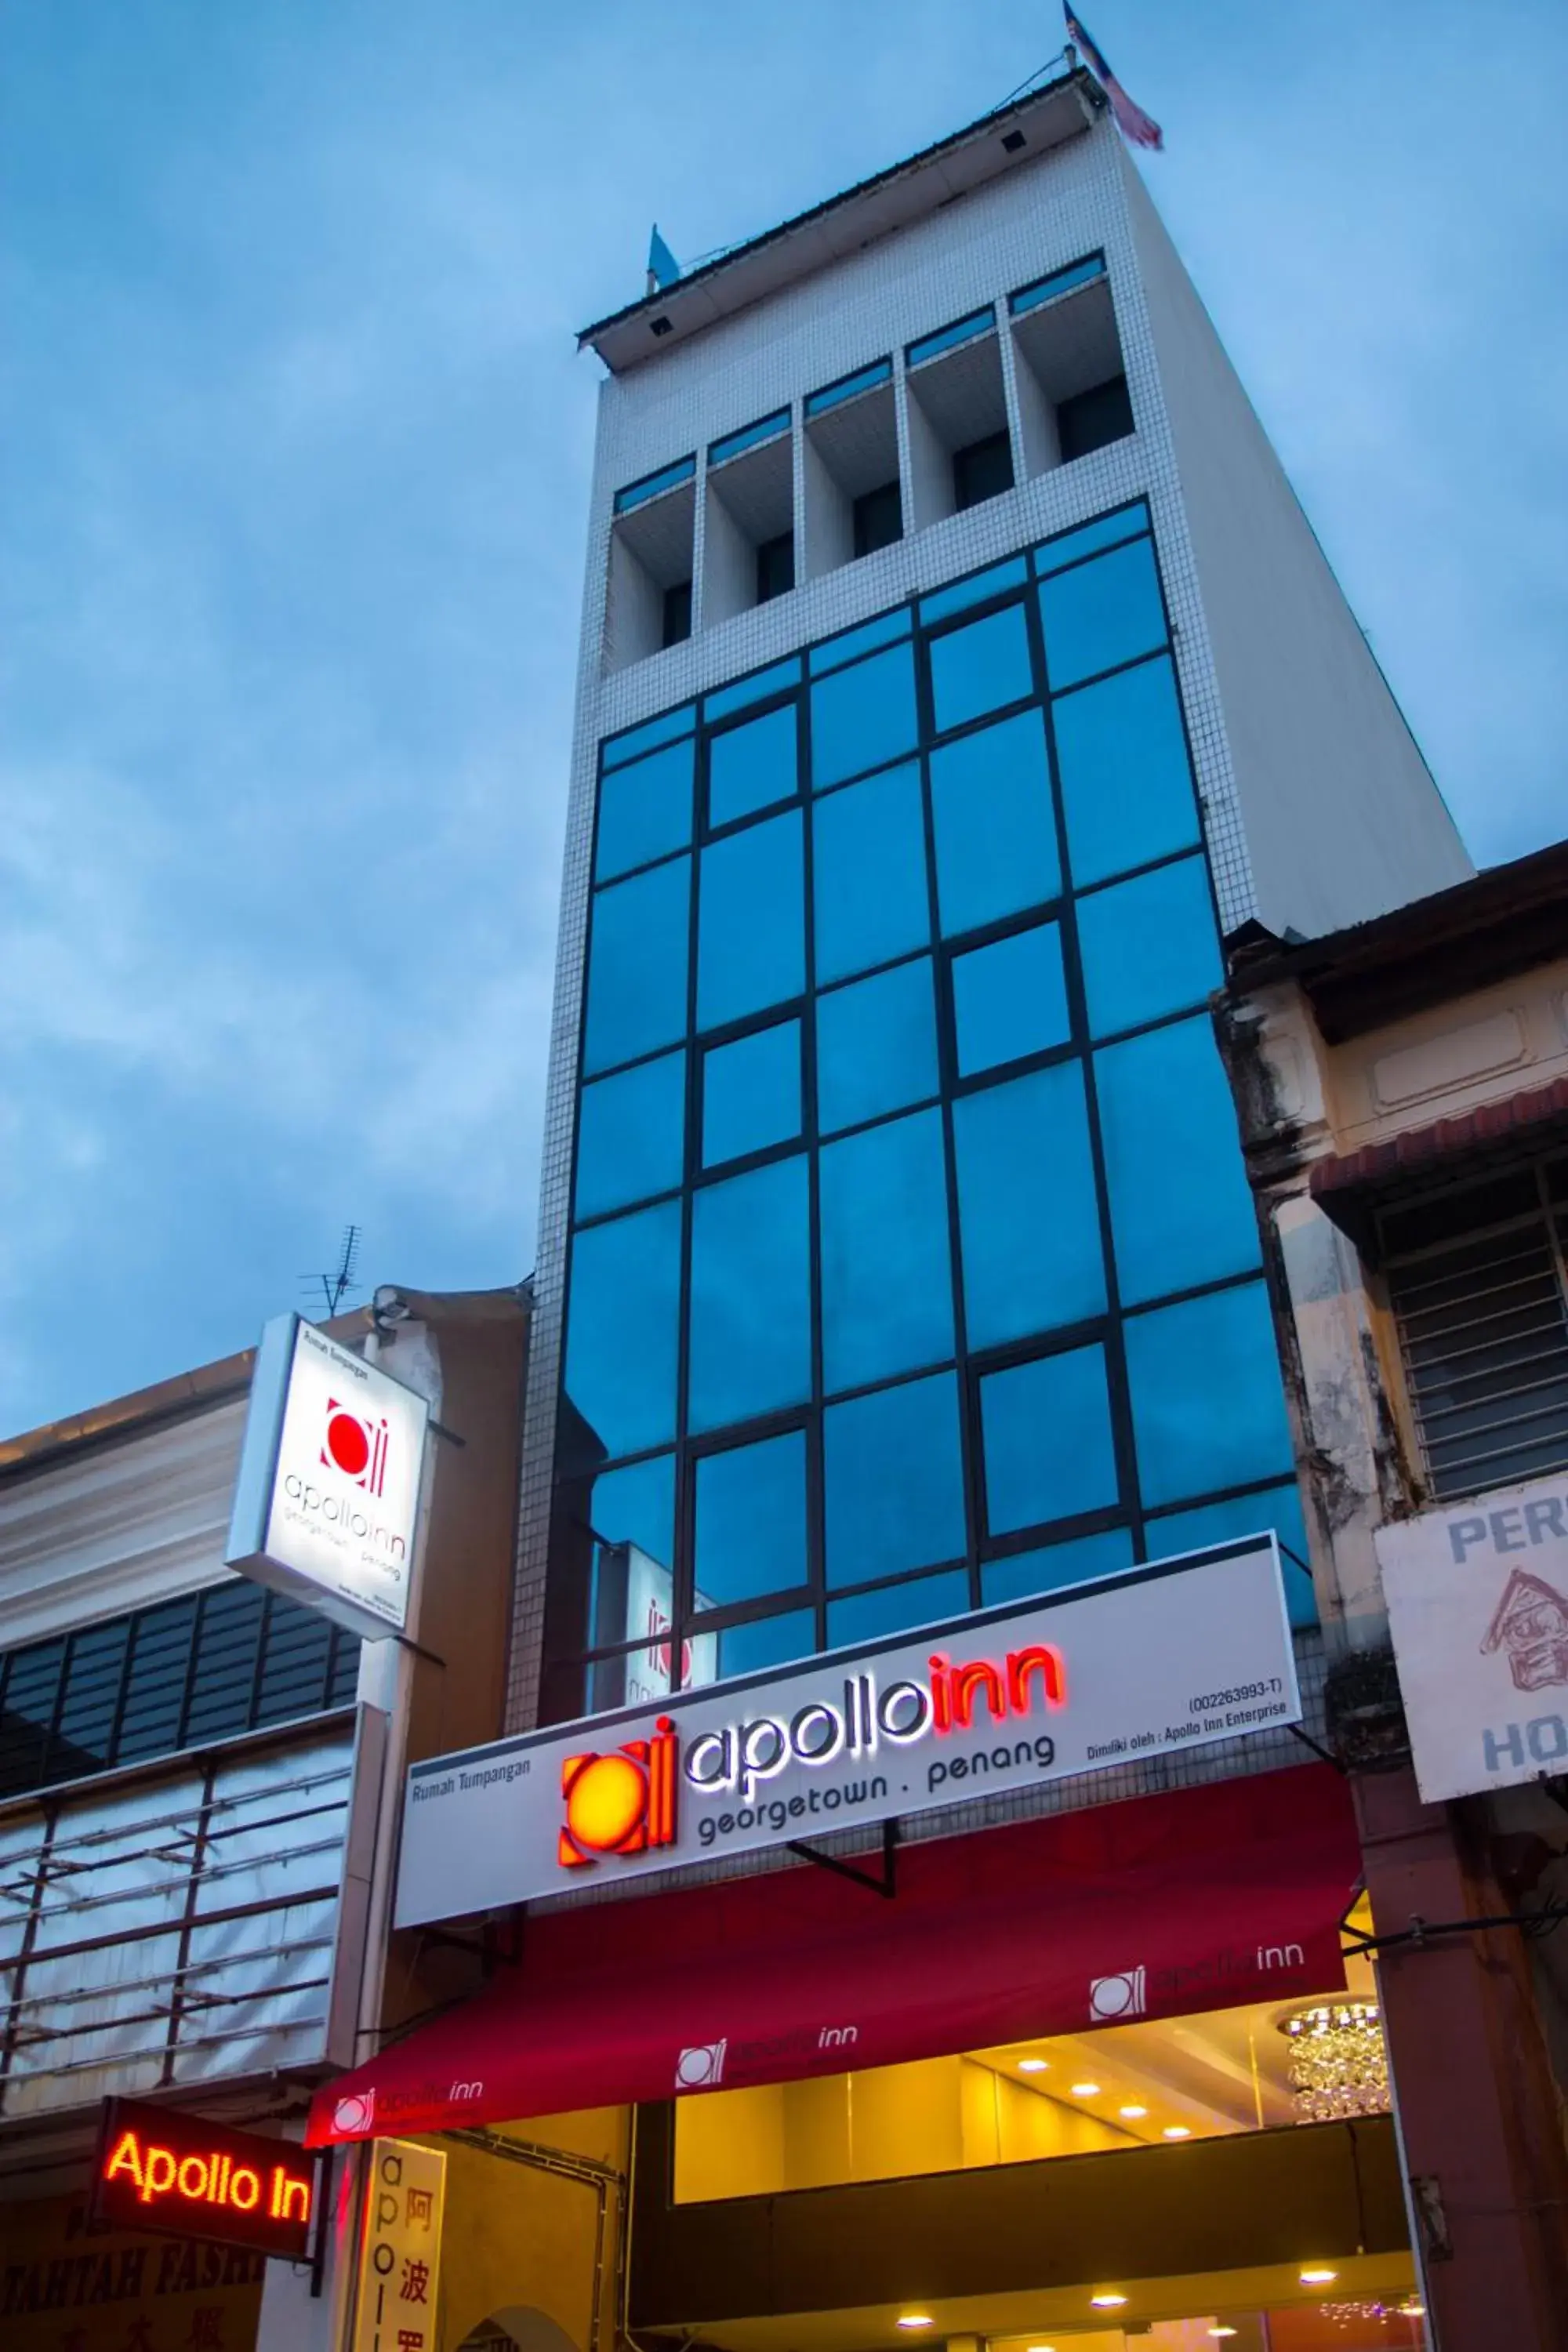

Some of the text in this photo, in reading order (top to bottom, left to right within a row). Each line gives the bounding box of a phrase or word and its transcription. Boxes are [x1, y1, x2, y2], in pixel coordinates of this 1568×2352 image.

[1449, 1496, 1568, 1564] PER
[1130, 1732, 1155, 1751] oleh
[1165, 1722, 1201, 1743] Apollo
[1204, 1718, 1224, 1732] Inn
[1226, 1700, 1287, 1728] Enterprise
[412, 1759, 531, 1802] Rumah Tumpangan
[698, 1775, 887, 1847] georgetown
[927, 1735, 1055, 1793] penang
[107, 2132, 260, 2209] Apollo
